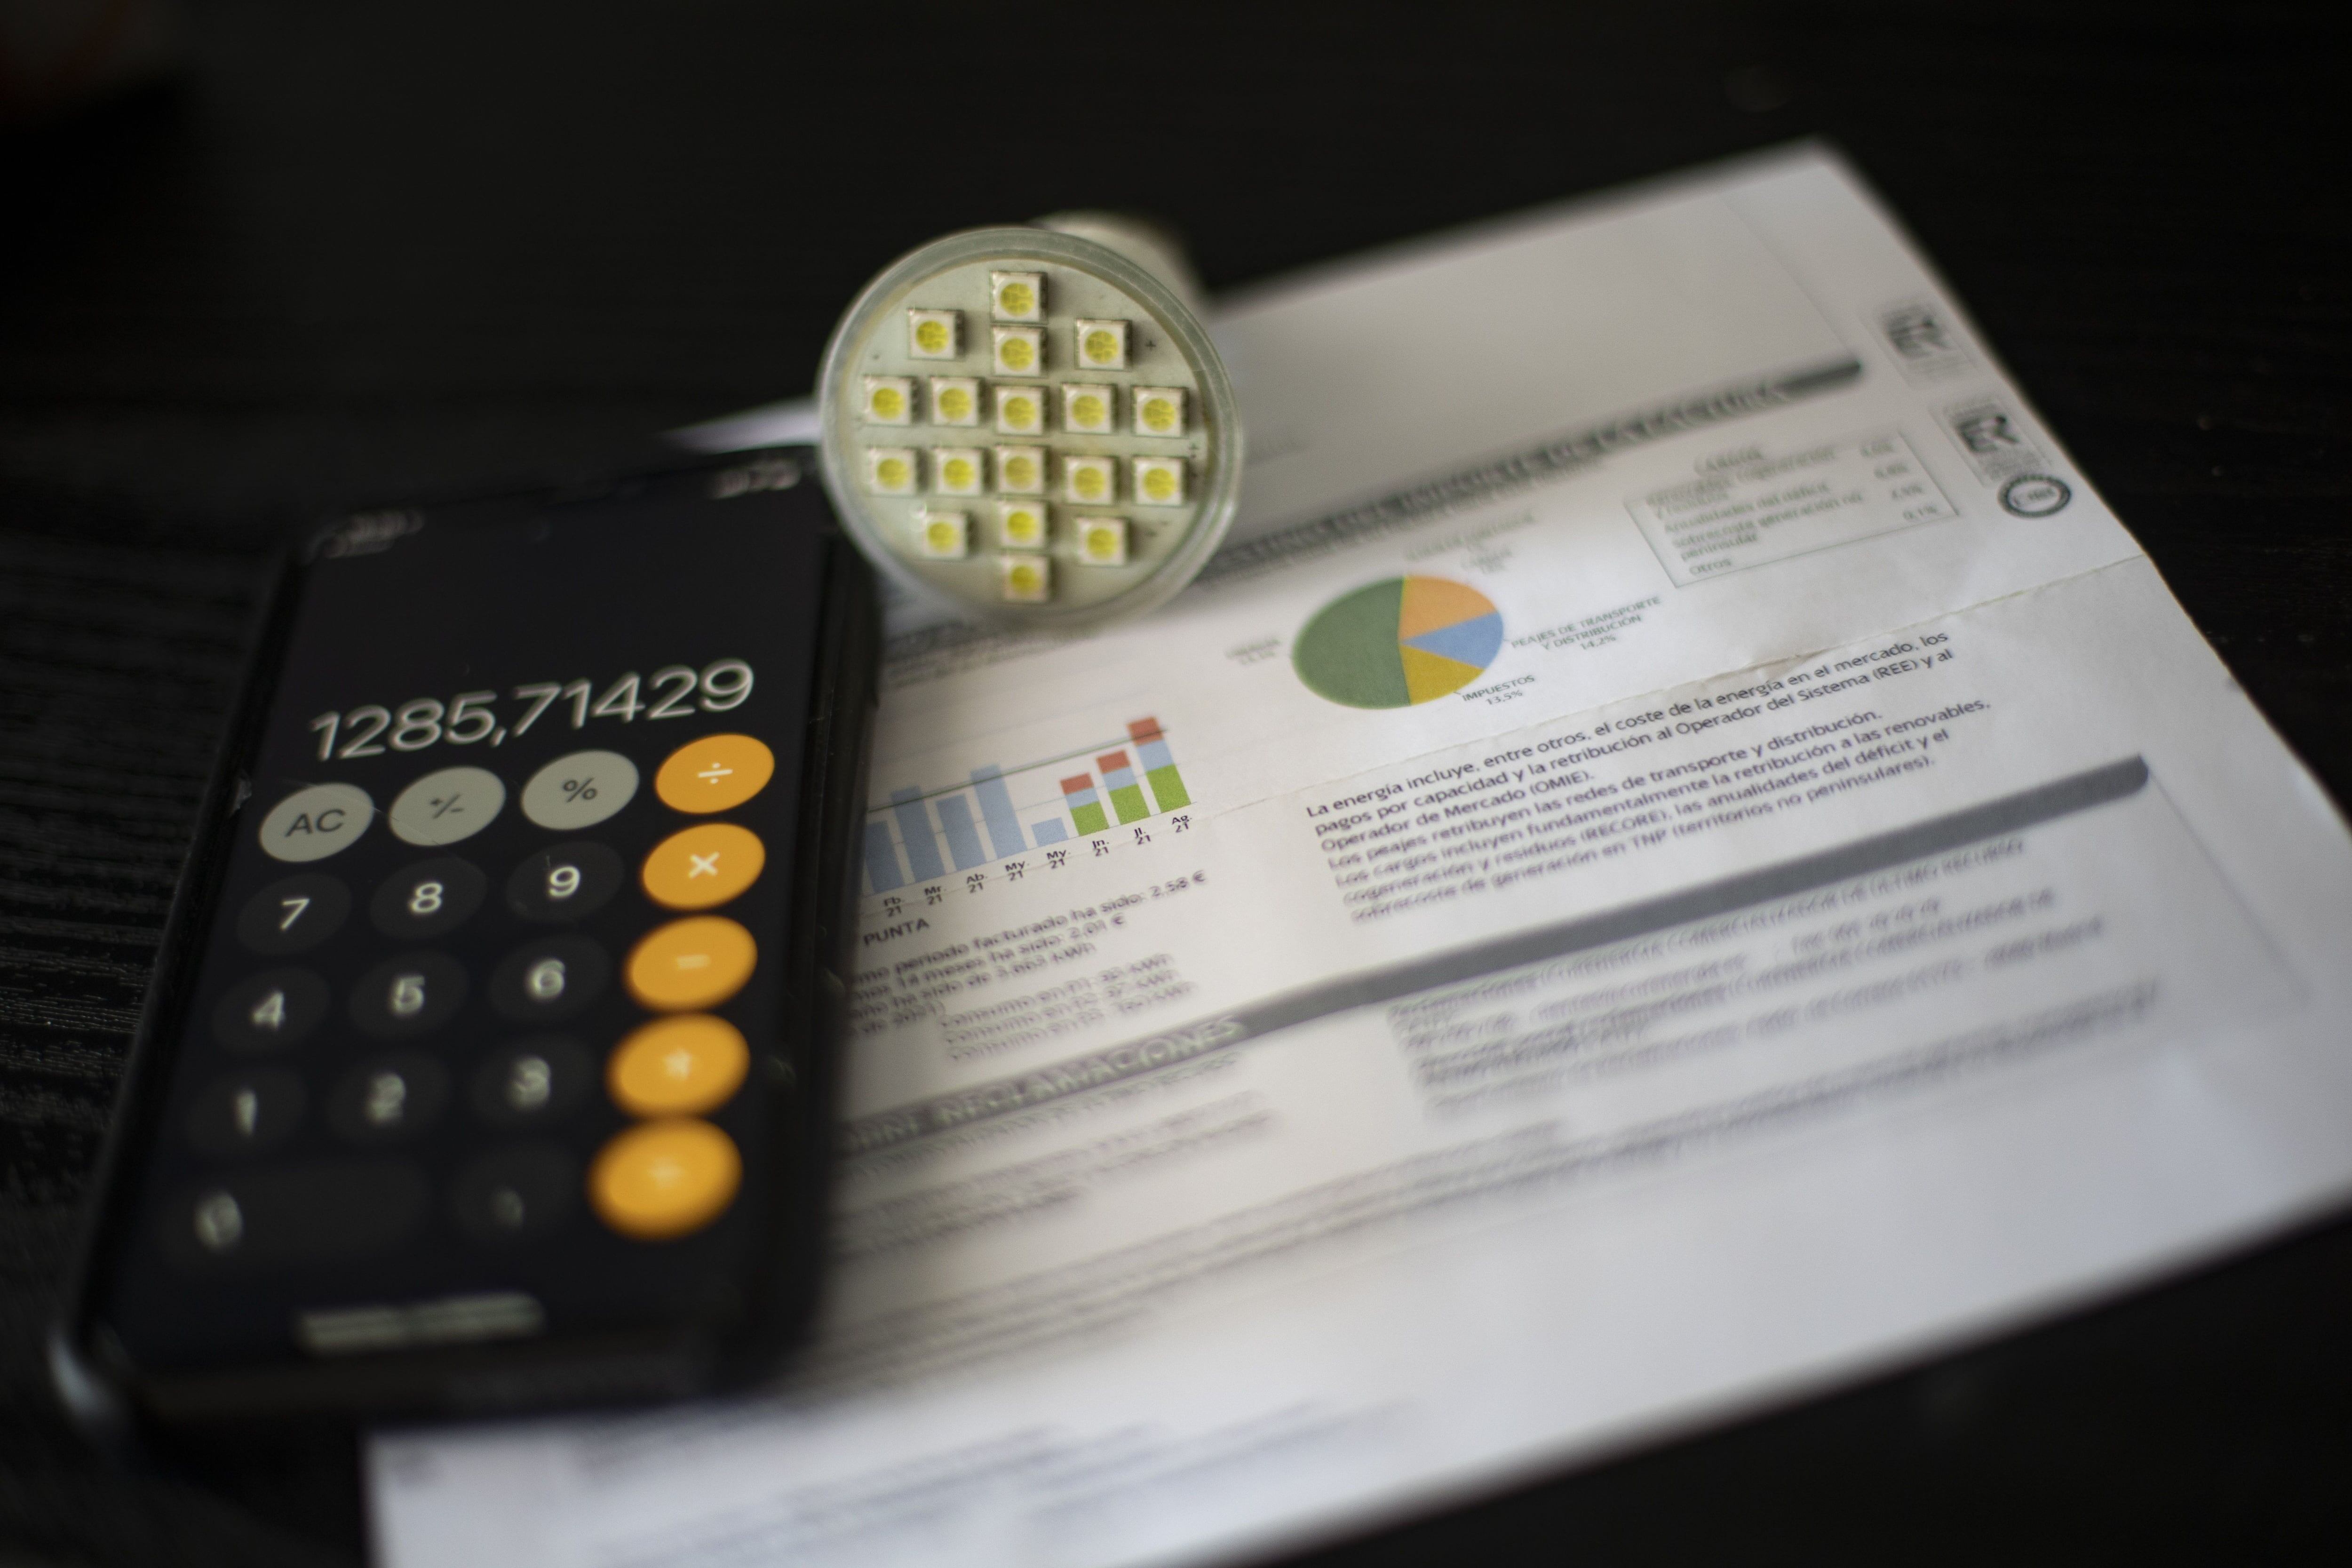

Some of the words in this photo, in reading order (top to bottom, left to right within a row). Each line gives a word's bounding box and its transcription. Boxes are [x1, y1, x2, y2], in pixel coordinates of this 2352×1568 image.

[1510, 629, 1553, 648] PEAJES
[1558, 623, 1576, 635] DE
[1579, 596, 1661, 628] TRANSPORTE
[1542, 641, 1551, 650] Y
[1462, 674, 1535, 701] IMPUESTOS
[311, 659, 755, 760] 1285,71429
[1306, 804, 1329, 818] La
[1332, 783, 1404, 810] energía
[1484, 746, 1533, 768] entre
[1594, 722, 1612, 735] el
[1615, 709, 1664, 730] coste
[1669, 703, 1692, 717] de
[1694, 697, 1712, 710] la
[1716, 680, 1784, 705] energía
[1787, 672, 1811, 685] en
[1814, 665, 1831, 678] el
[1919, 631, 1949, 647] los
[1315, 811, 1372, 837] pagos
[1377, 801, 1409, 820] por
[1413, 771, 1509, 806] capacidad
[1511, 769, 1524, 783] y
[1527, 762, 1546, 776] la
[1549, 732, 1653, 770] retribución
[1656, 726, 1673, 740] al
[1676, 704, 1762, 734] Operador
[1766, 693, 1795, 711] del
[1797, 673, 1870, 701] Sistema
[1872, 659, 1918, 680] (REE)
[1920, 655, 1933, 669] y
[1937, 648, 1953, 662] al
[1674, 800, 1703, 817] las
[1707, 768, 1819, 808] anualidades
[1821, 756, 1851, 775] del
[1915, 736, 1928, 749] y
[1931, 728, 1949, 742] el
[1327, 852, 1362, 870] Los
[1366, 835, 1427, 862] peajes
[1432, 806, 1532, 841] retribuyen
[1534, 797, 1562, 814] las
[1565, 783, 1618, 805] redes
[1621, 775, 1646, 791] de
[1649, 748, 1748, 782] transporte
[1750, 744, 1763, 758] y
[1440, 828, 1524, 860] incluyen
[1526, 778, 1709, 836] fundamentalmente
[1711, 772, 1732, 787] la
[1734, 741, 1836, 780] retribución
[1840, 738, 1852, 749] a
[1853, 728, 1881, 745] las
[1776, 794, 1802, 810] no
[285, 809, 347, 838] AC
[1172, 815, 1192, 825] Ag.
[1320, 820, 1411, 852] Operador
[1415, 812, 1441, 826] de
[1443, 788, 1526, 819] Mercado
[1529, 770, 1595, 795] (OMIE).
[1137, 835, 1152, 845] 21
[1175, 822, 1189, 833] 21
[1004, 860, 1030, 872] My.
[1046, 849, 1071, 860] My.
[1050, 858, 1065, 869] 21
[1095, 846, 1109, 857] 21
[547, 865, 581, 899] 9
[969, 882, 984, 893] 21
[1008, 870, 1024, 882] 21
[409, 882, 444, 915] 8
[886, 906, 902, 917] 21
[927, 894, 942, 906] 21
[281, 898, 310, 931] 7
[863, 917, 930, 946] PUNTA
[525, 958, 565, 1000] 6
[253, 990, 285, 1027] 4
[389, 975, 426, 1016] 5
[508, 1056, 552, 1111] 3
